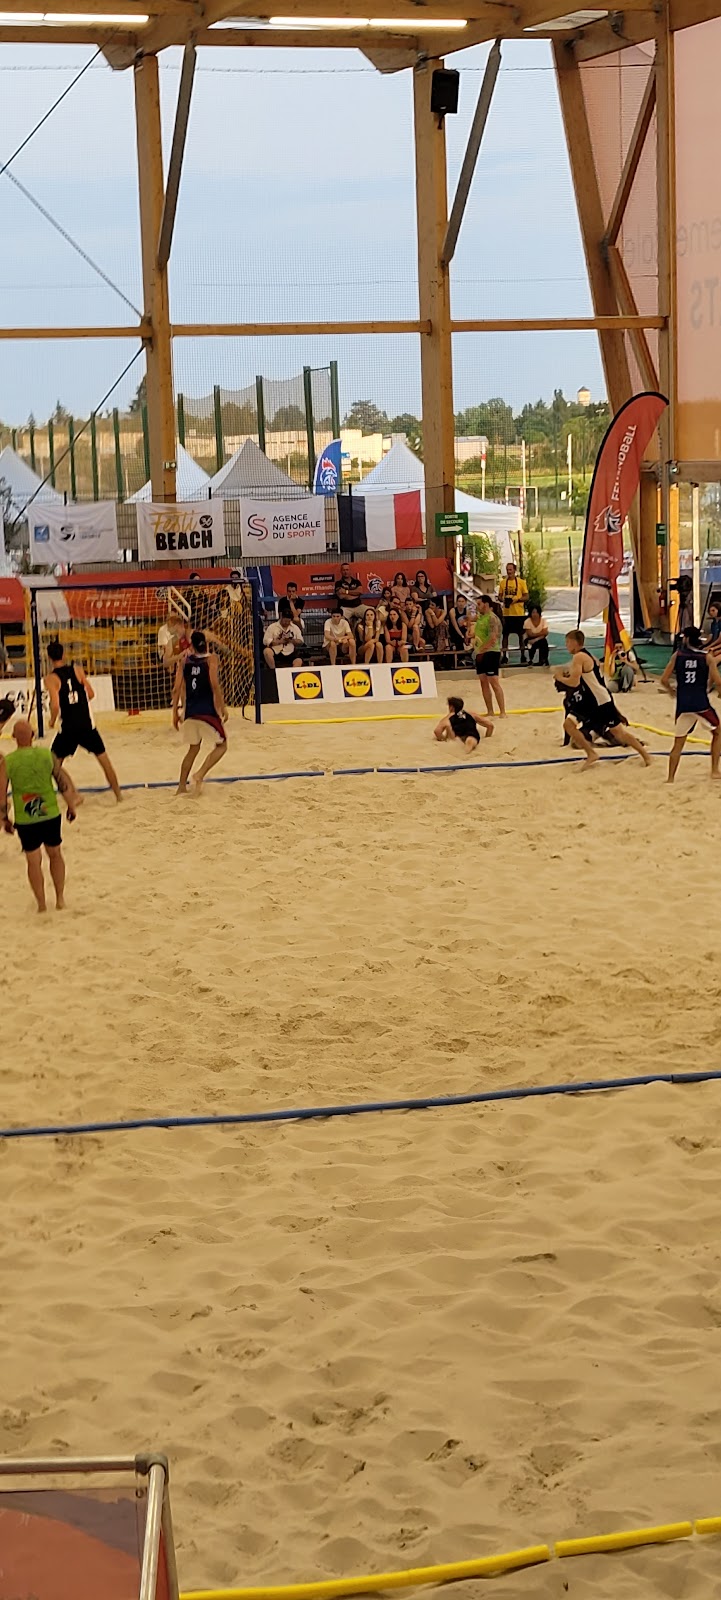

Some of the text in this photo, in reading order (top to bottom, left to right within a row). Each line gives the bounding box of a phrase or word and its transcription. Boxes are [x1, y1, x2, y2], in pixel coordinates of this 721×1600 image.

[149, 510, 200, 537] Festi
[273, 514, 308, 523] AGENCE
[273, 521, 321, 531] NATIONALE
[155, 530, 213, 551] BEACH
[287, 530, 316, 539] SPORT
[684, 671, 696, 684] 33
[191, 678, 197, 690] 6
